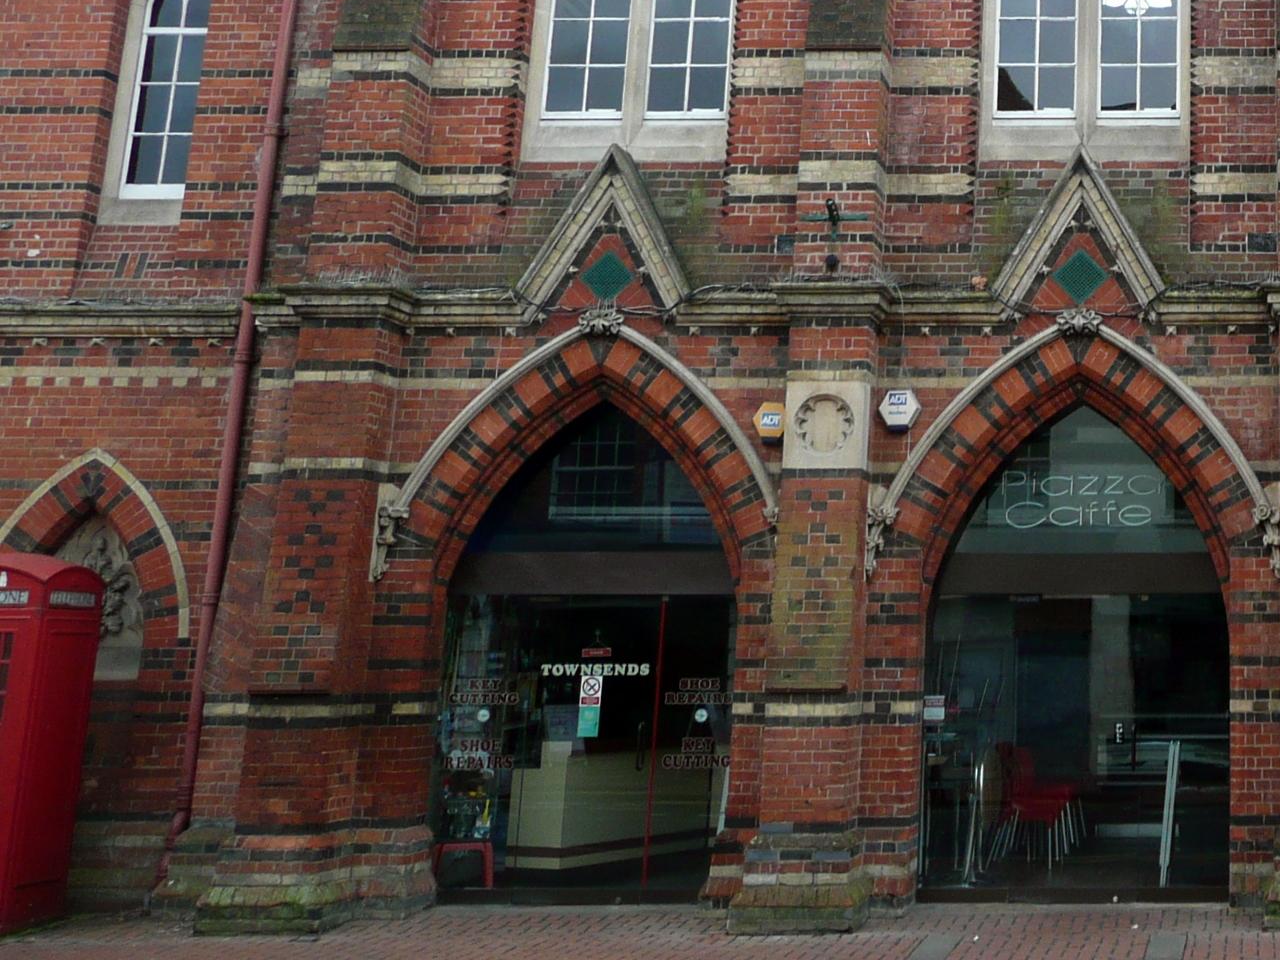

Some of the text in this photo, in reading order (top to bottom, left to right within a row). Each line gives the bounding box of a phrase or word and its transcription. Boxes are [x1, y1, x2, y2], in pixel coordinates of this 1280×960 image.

[889, 393, 906, 404] ADT
[762, 413, 780, 426] ADT
[1002, 470, 1161, 496] Piazza
[1005, 500, 1151, 529] Caffe
[541, 663, 650, 676] TOWNSENDS
[468, 679, 501, 690] KEY
[679, 678, 720, 690] SHOE
[450, 692, 519, 705] CUTTING
[460, 739, 500, 752] SHOE
[681, 737, 714, 753] KEY
[444, 755, 513, 769] REPAIRS
[662, 753, 731, 769] CUTTING
